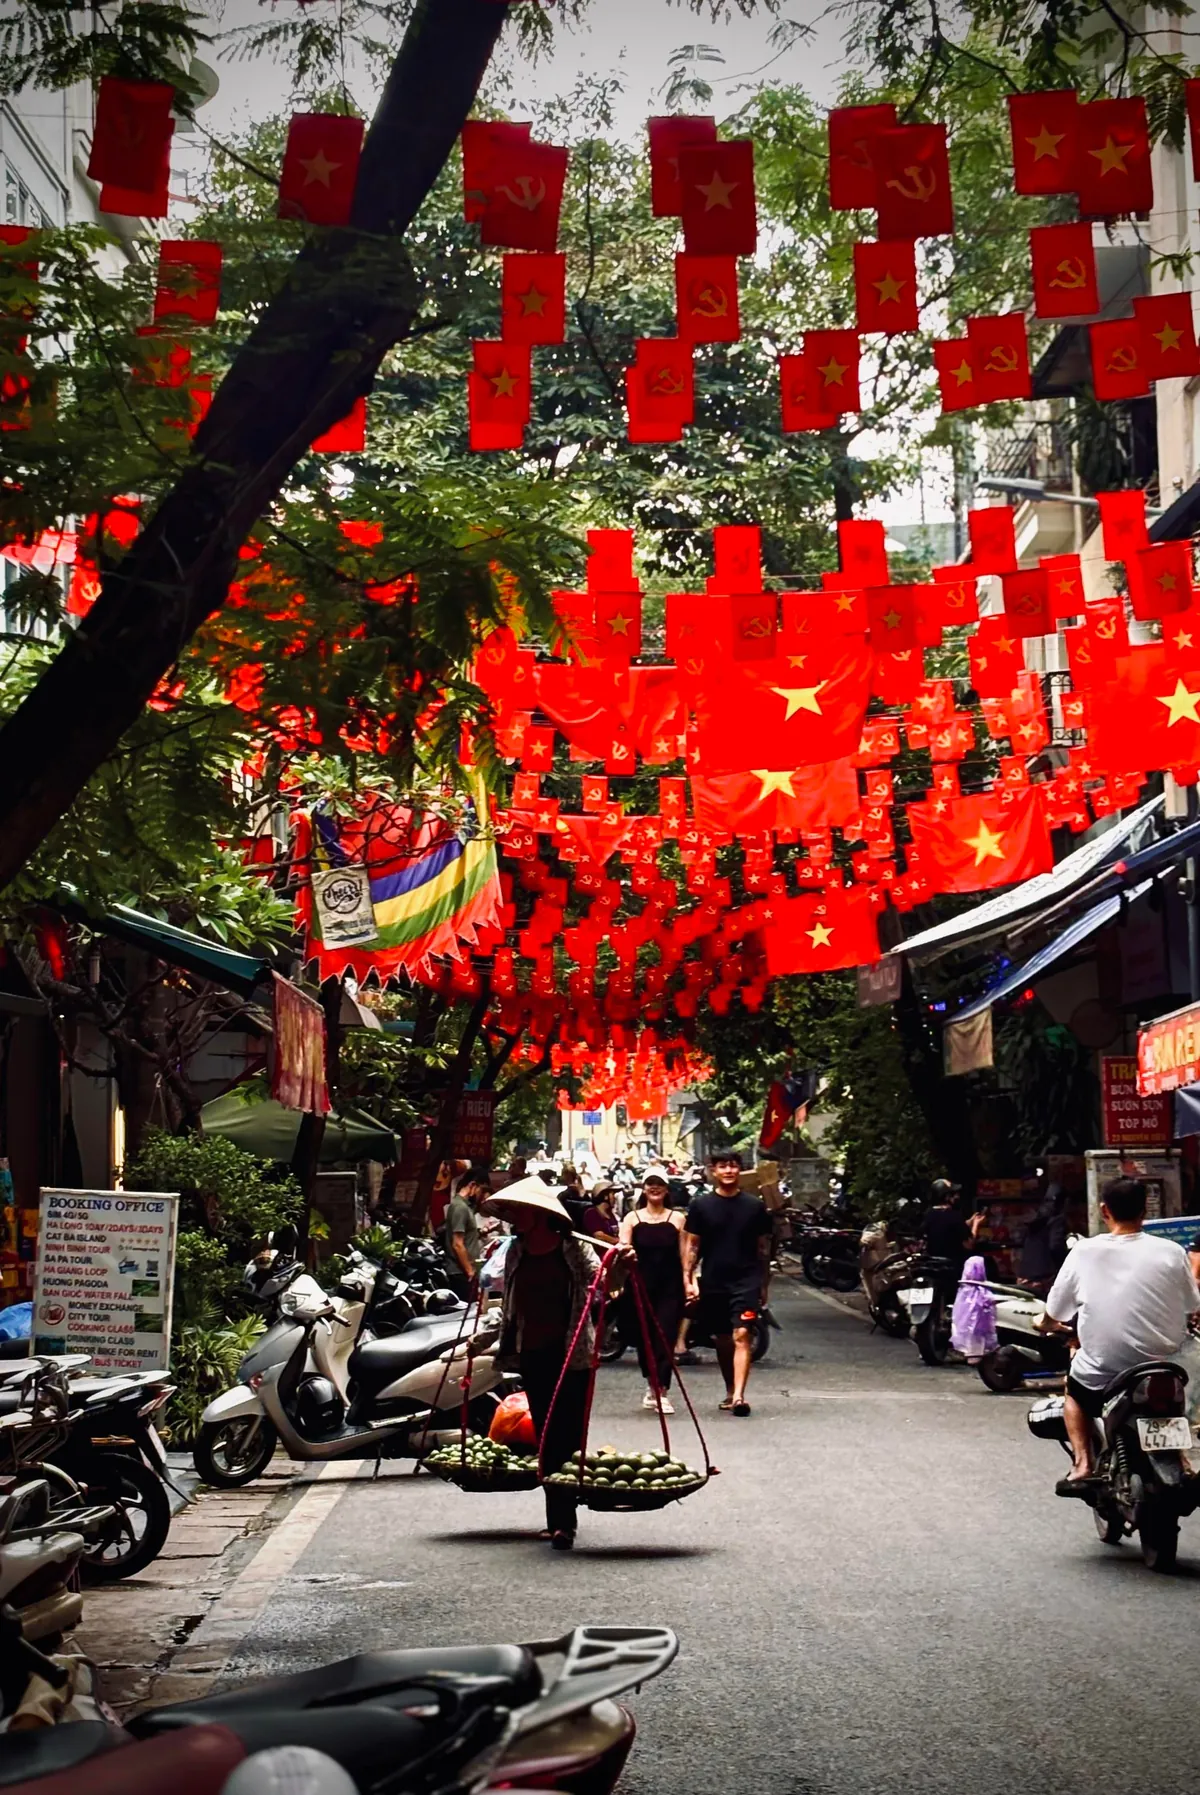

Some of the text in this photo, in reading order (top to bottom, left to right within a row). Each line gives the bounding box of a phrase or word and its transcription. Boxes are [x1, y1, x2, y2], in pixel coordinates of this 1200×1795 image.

[49, 1197, 164, 1213] BOOKING OFFICE
[46, 1222, 57, 1230] HA
[60, 1223, 83, 1231] LONG
[46, 1232, 107, 1243] CAT BA ISLAND
[44, 1244, 65, 1252] NINH
[67, 1244, 86, 1253] BINH
[88, 1245, 111, 1254] TOUR
[58, 1255, 68, 1263] PA
[70, 1256, 93, 1265] TOUR
[43, 1266, 108, 1276] HA GIANG LOOP
[43, 1278, 108, 1289] HUONG PAGODA
[42, 1288, 60, 1297] BAN
[83, 1290, 112, 1300] WATER
[68, 1301, 144, 1313] MONEY EXCHANGE
[68, 1312, 110, 1321] CITY TOUR
[67, 1323, 106, 1332] COOKING
[66, 1334, 135, 1345] DRINKING CLASS
[67, 1346, 159, 1358] MOTOR BIKE FOR RENT
[95, 1358, 142, 1368] BUS TICKET
